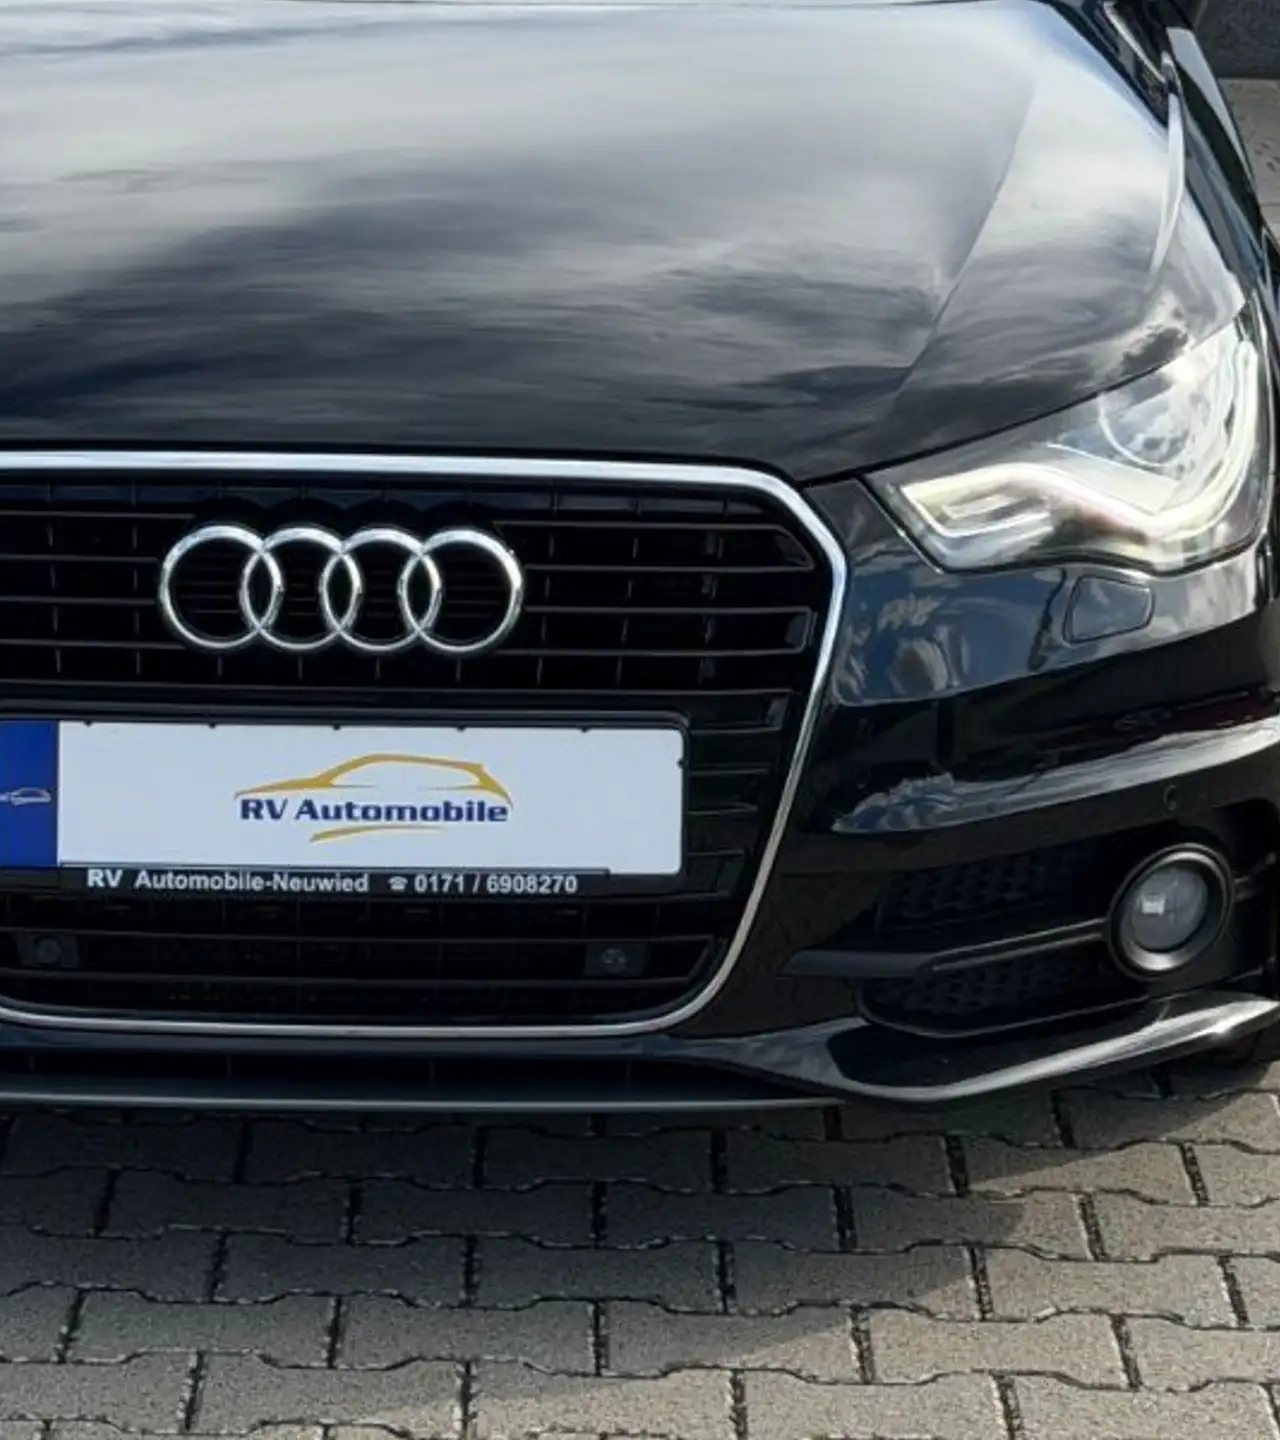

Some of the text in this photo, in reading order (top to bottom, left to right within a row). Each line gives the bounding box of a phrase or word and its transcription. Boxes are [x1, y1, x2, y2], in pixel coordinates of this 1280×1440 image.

[240, 798, 508, 823] RV Automobile
[86, 869, 123, 889] RV
[134, 870, 370, 893] Automobile-Neuwied
[414, 874, 465, 894] 0171
[486, 875, 578, 895] 6908270
